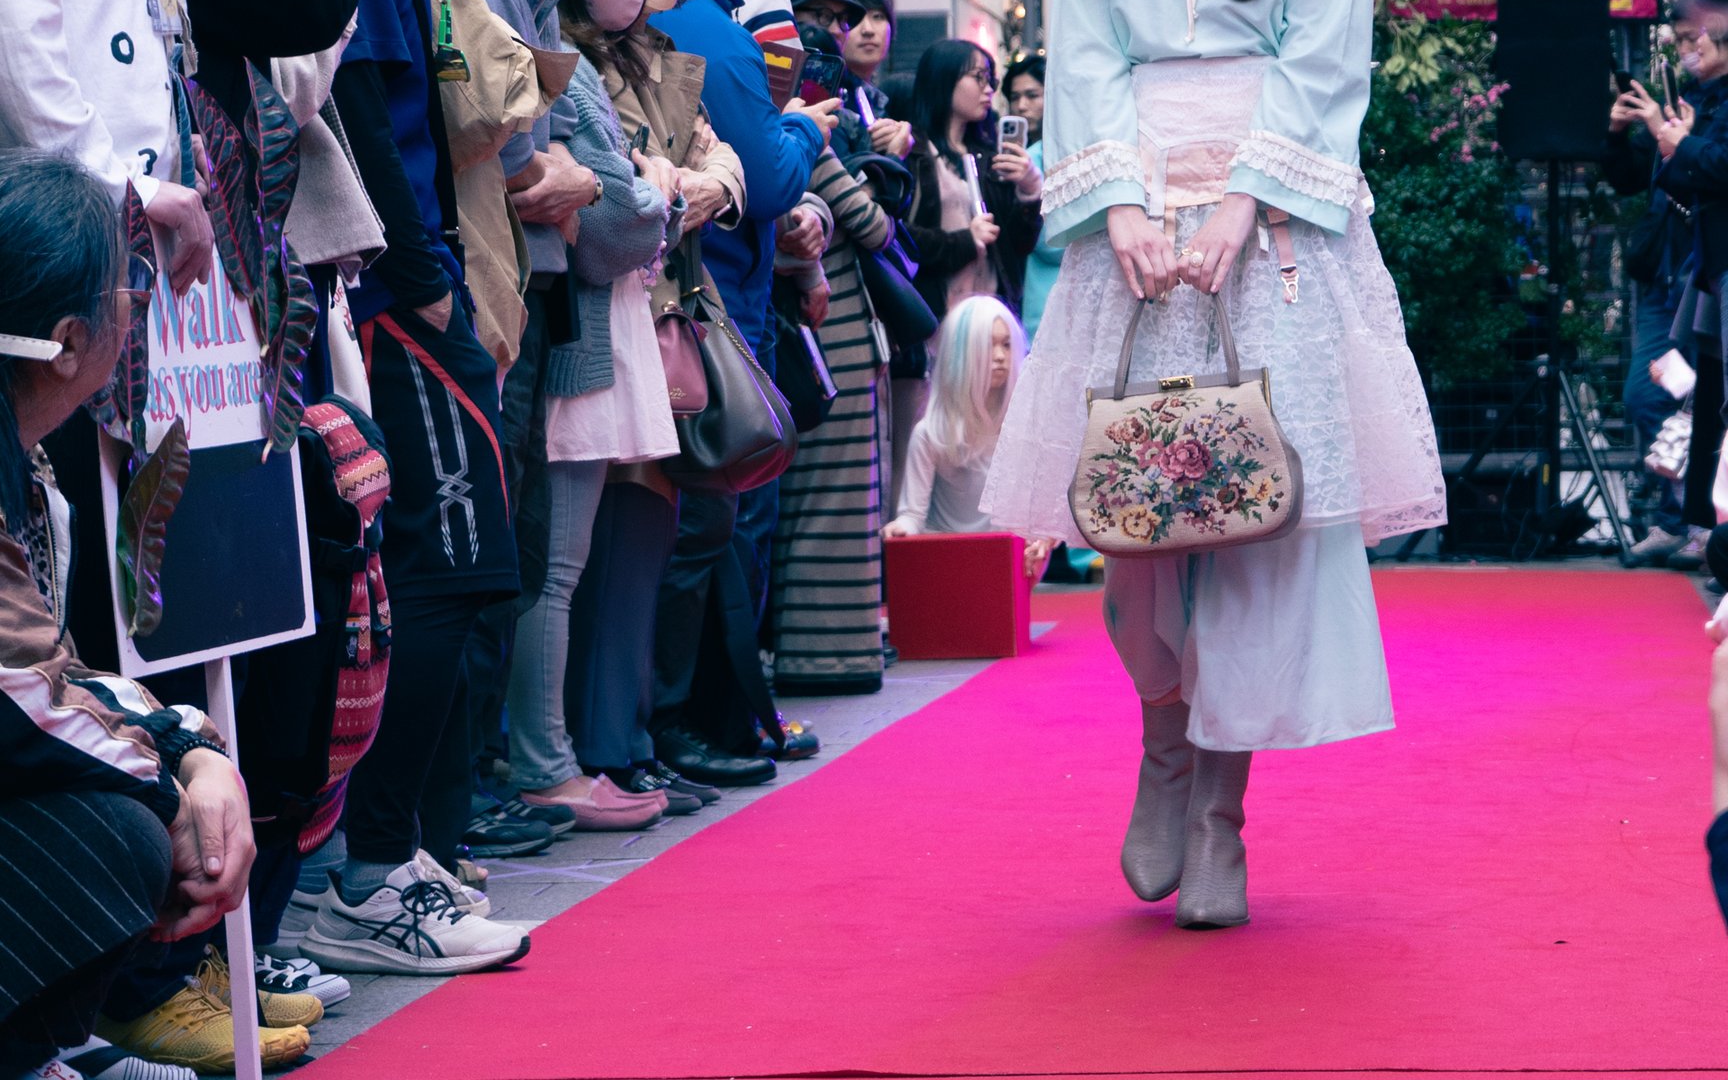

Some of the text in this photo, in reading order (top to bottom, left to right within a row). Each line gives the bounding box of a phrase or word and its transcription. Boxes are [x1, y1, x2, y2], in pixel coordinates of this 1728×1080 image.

[150, 255, 247, 357] Walk
[145, 360, 264, 441] as you are
